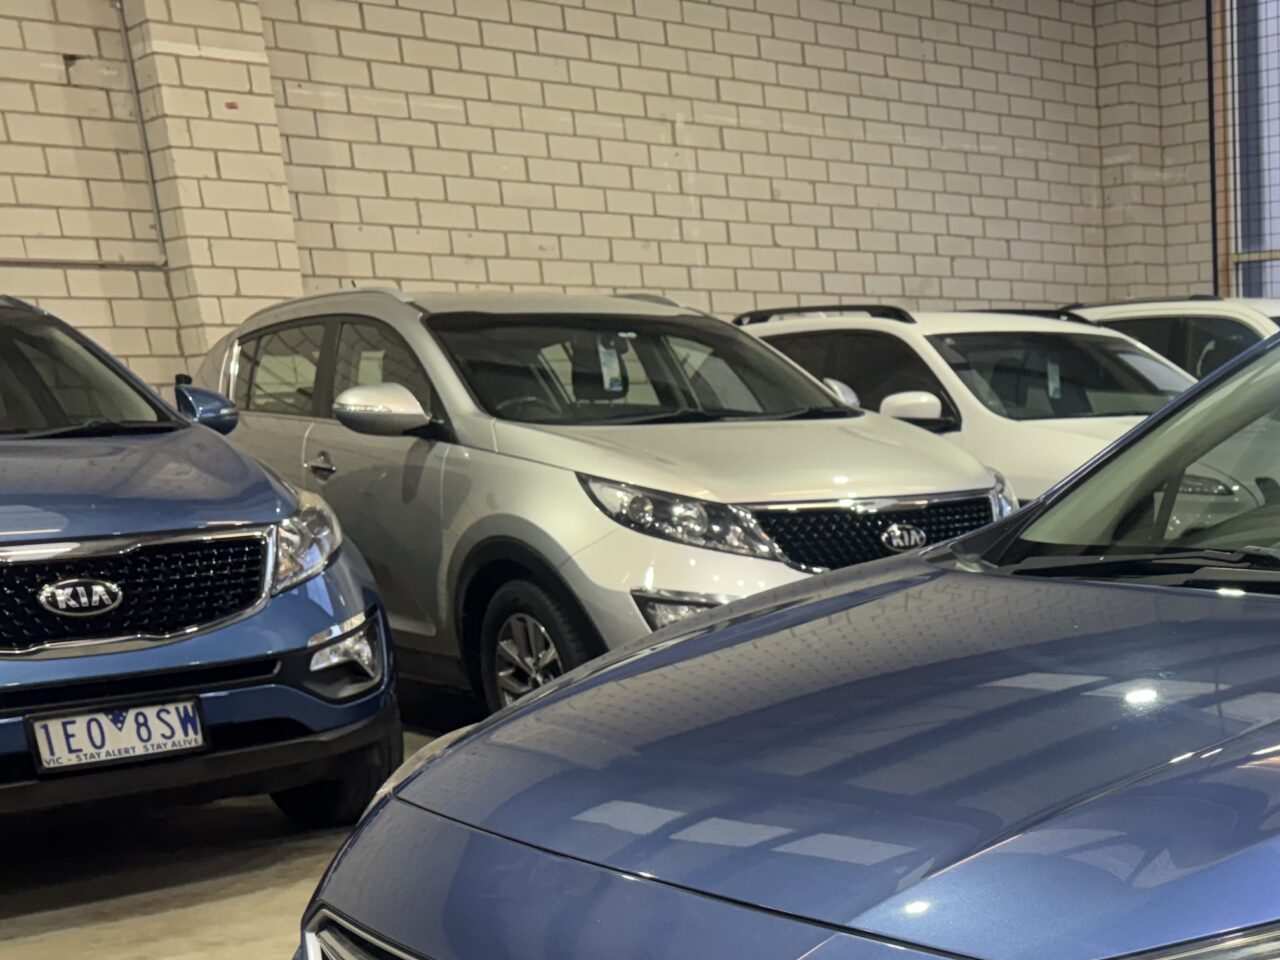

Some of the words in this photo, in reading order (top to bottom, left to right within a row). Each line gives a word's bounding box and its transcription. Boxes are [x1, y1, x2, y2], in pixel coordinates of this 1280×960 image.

[889, 529, 921, 548] KIA
[54, 586, 112, 609] KIA
[134, 705, 200, 743] 8SW
[44, 756, 63, 766] VIC
[75, 752, 102, 763] STAY
[105, 746, 136, 758] ALERT
[143, 742, 168, 752] STAY
[171, 737, 200, 748] ALIVE
